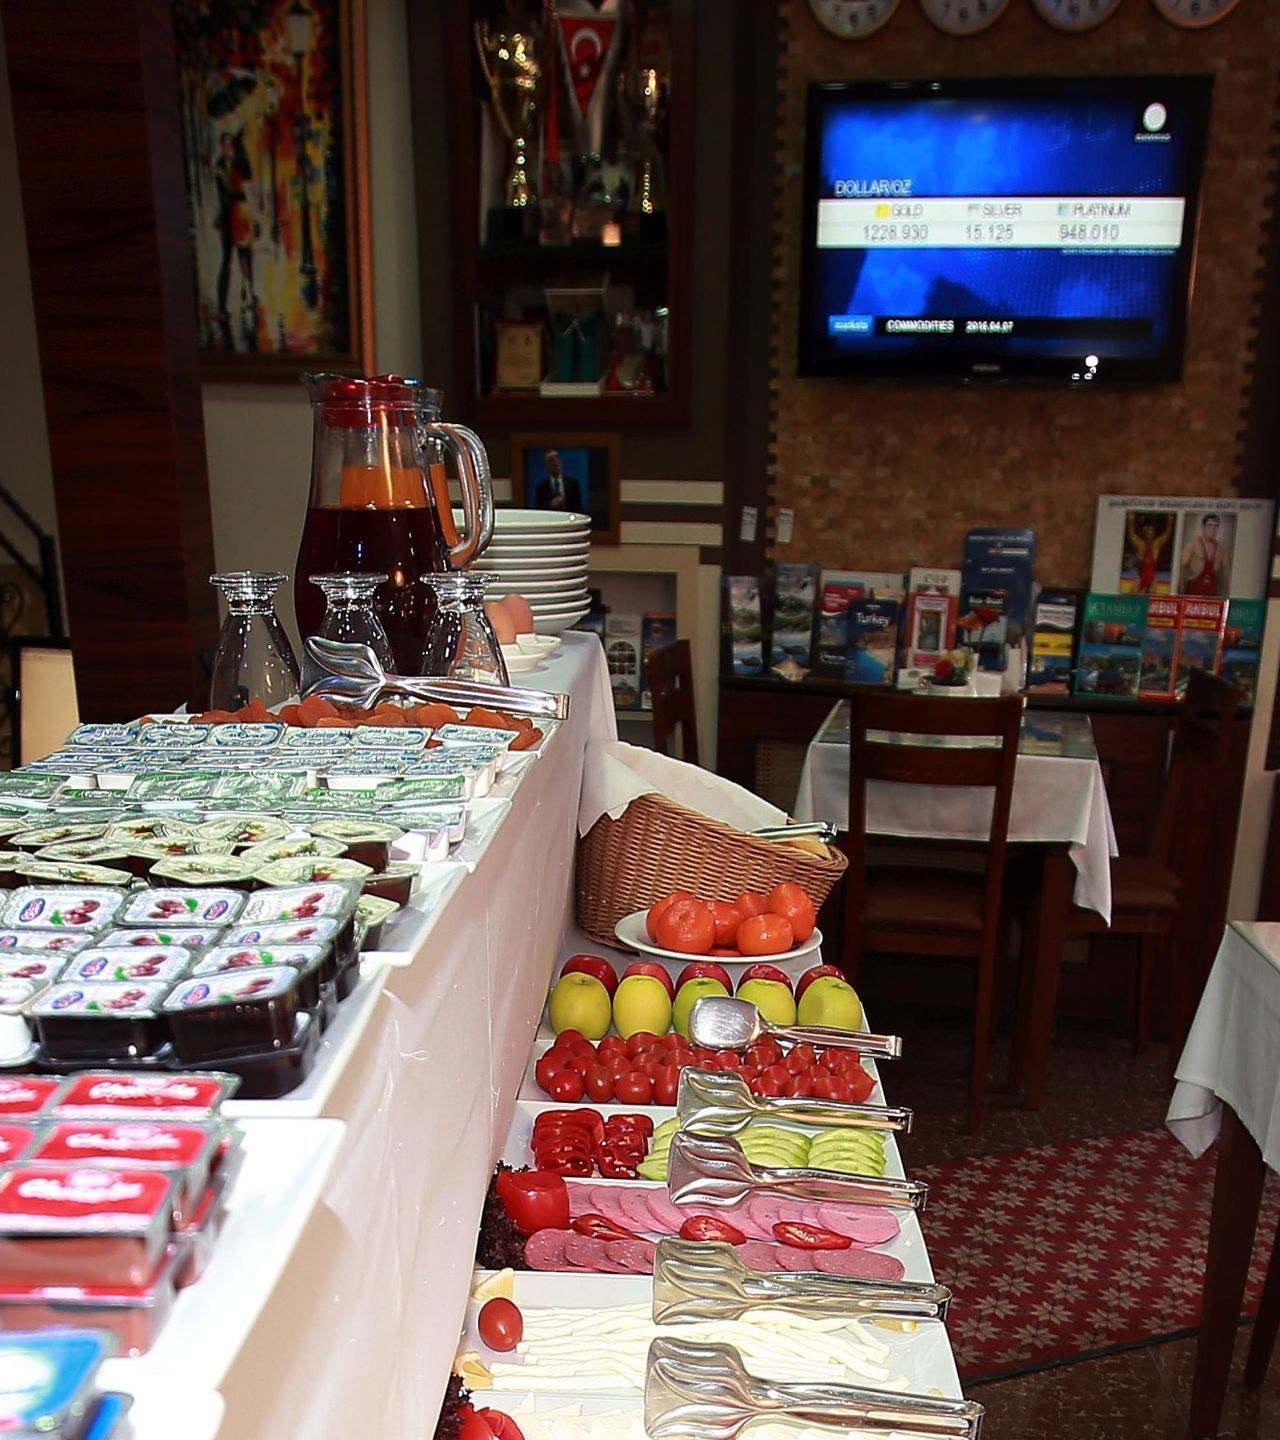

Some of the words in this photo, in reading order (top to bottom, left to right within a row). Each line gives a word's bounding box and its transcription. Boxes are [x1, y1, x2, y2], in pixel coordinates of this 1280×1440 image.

[892, 203, 924, 219] GOLD
[982, 203, 1023, 218] SILVER
[1072, 203, 1132, 218] PLATINUM
[885, 319, 955, 334] COMMODITIES
[855, 611, 891, 628] Turkey
